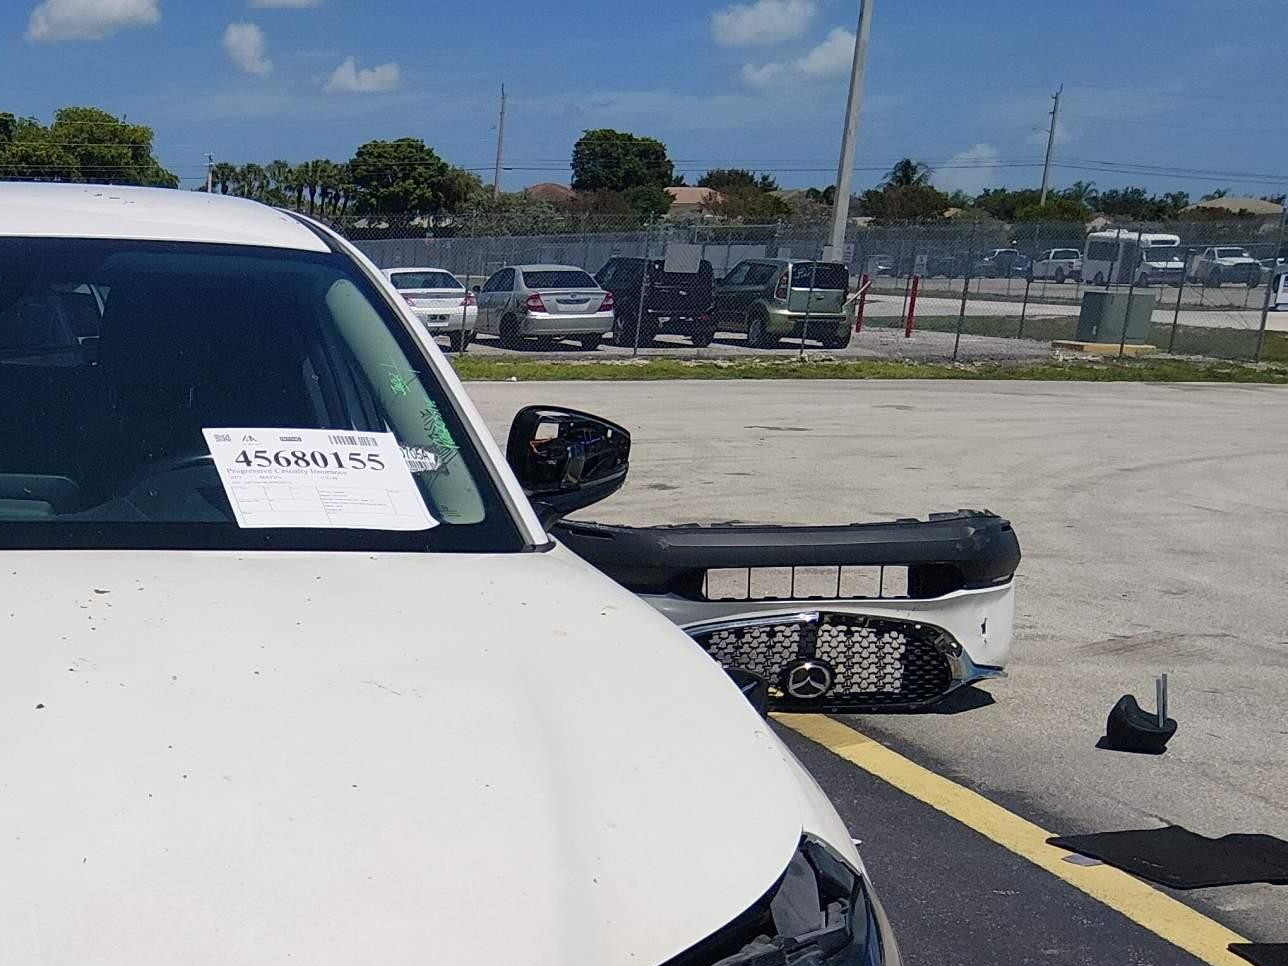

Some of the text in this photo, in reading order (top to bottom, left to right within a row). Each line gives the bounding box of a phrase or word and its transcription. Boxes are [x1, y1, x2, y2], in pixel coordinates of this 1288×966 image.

[235, 449, 385, 471] 45680155
[226, 467, 348, 476] Progressive Casualty Insurance
